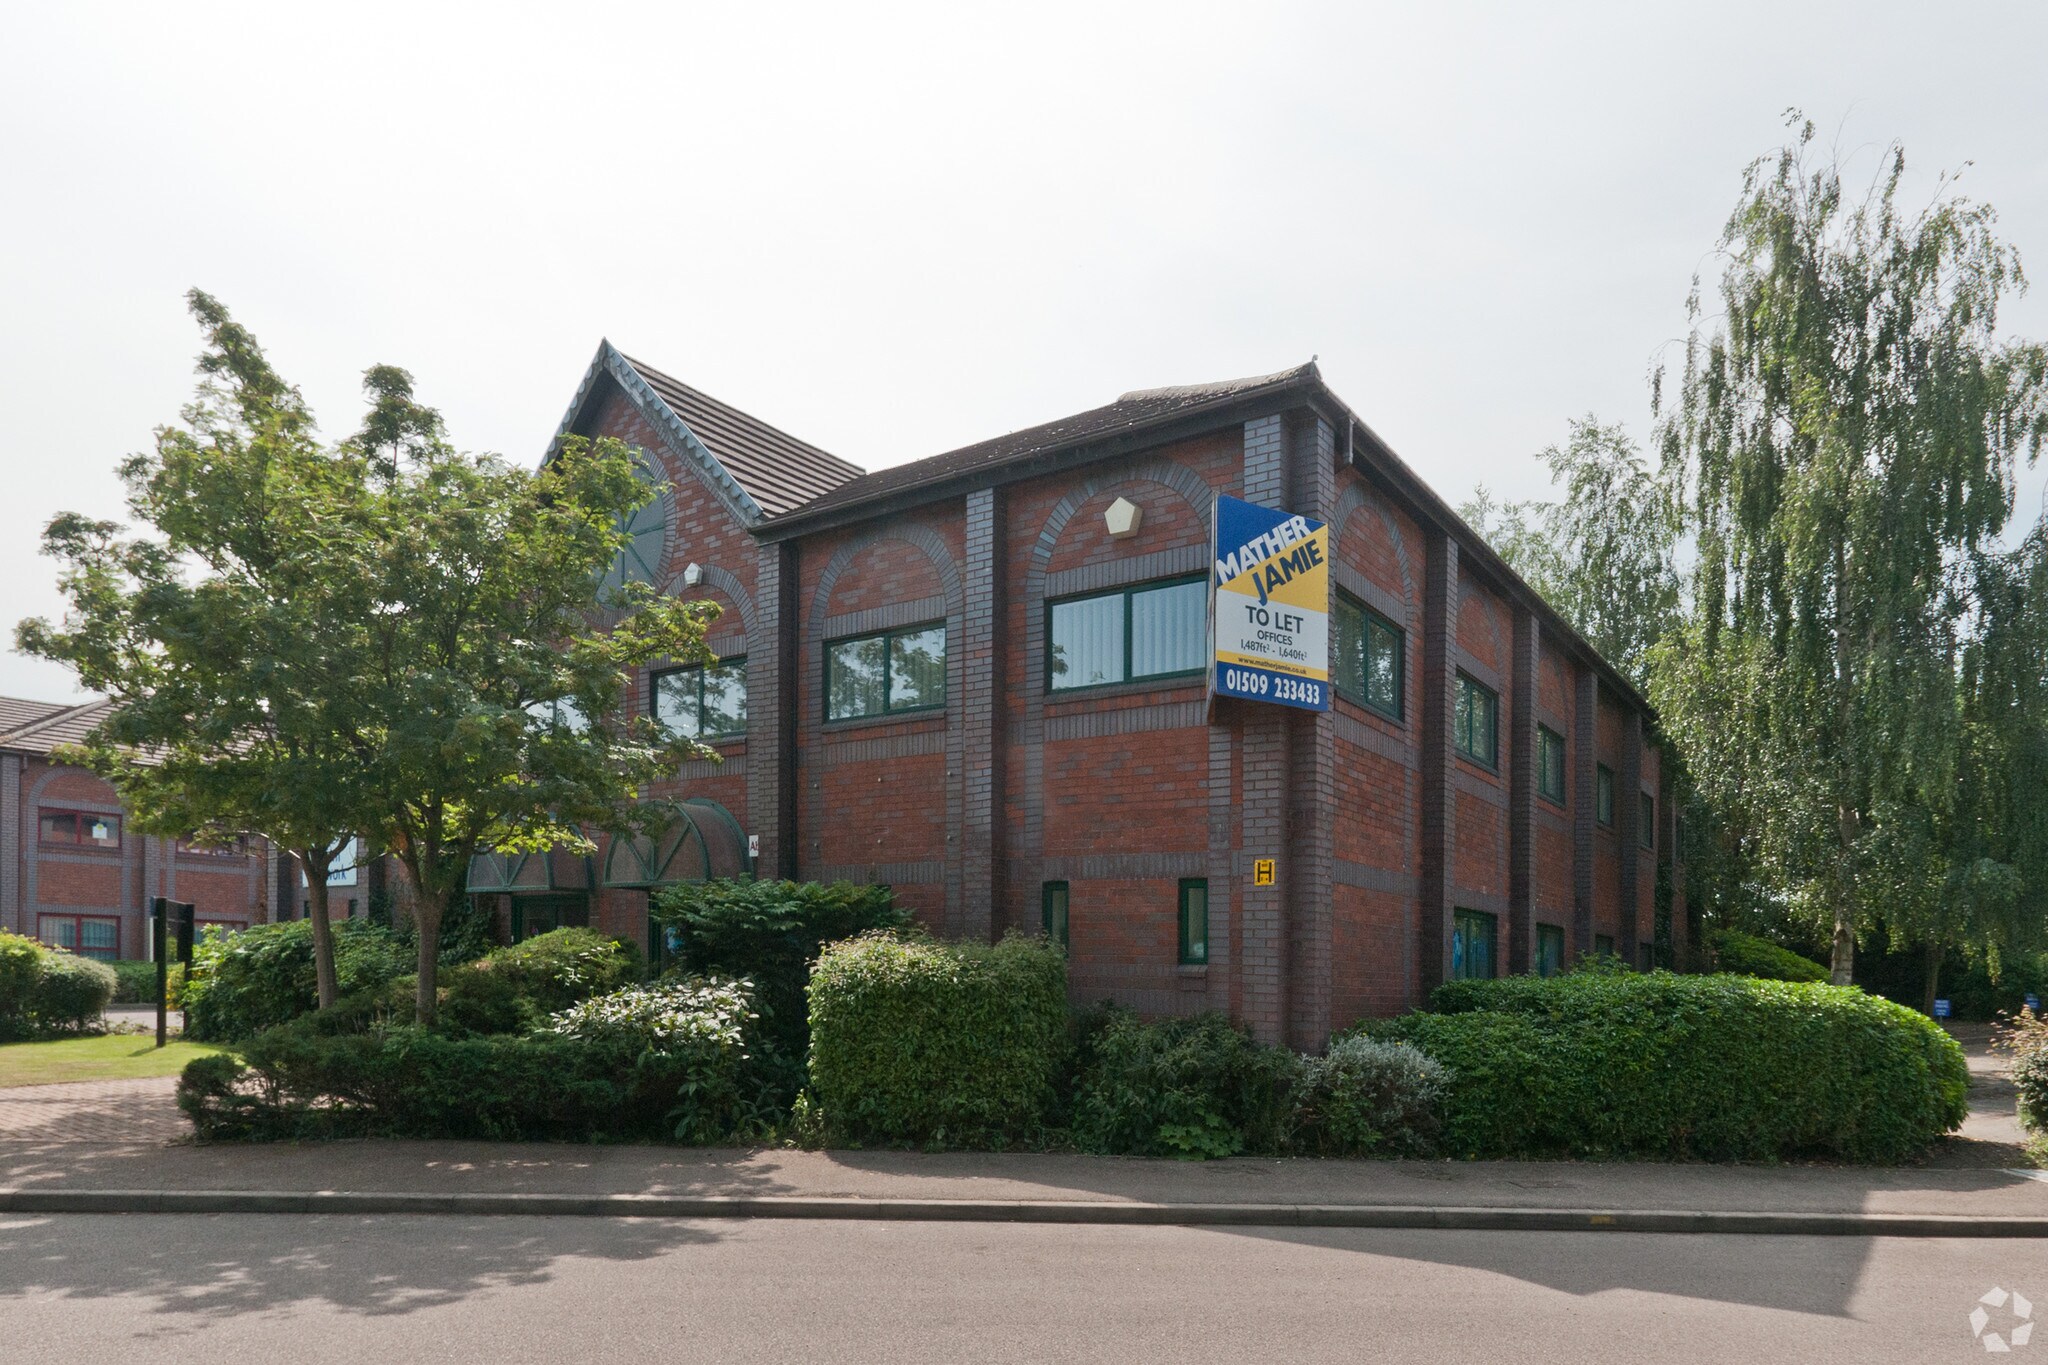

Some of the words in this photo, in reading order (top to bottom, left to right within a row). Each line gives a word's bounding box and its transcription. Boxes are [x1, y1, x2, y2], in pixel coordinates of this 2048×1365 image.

[1216, 515, 1312, 585] MATHER
[1252, 539, 1324, 606] JAMIE
[1245, 605, 1269, 626] TO
[1275, 612, 1304, 634] LET
[1257, 630, 1293, 645] OFFICES
[1238, 657, 1307, 675] www.matherjamie.co.uk
[1227, 669, 1268, 695] 01509
[1275, 677, 1320, 705] 233433
[1258, 862, 1272, 883] H
